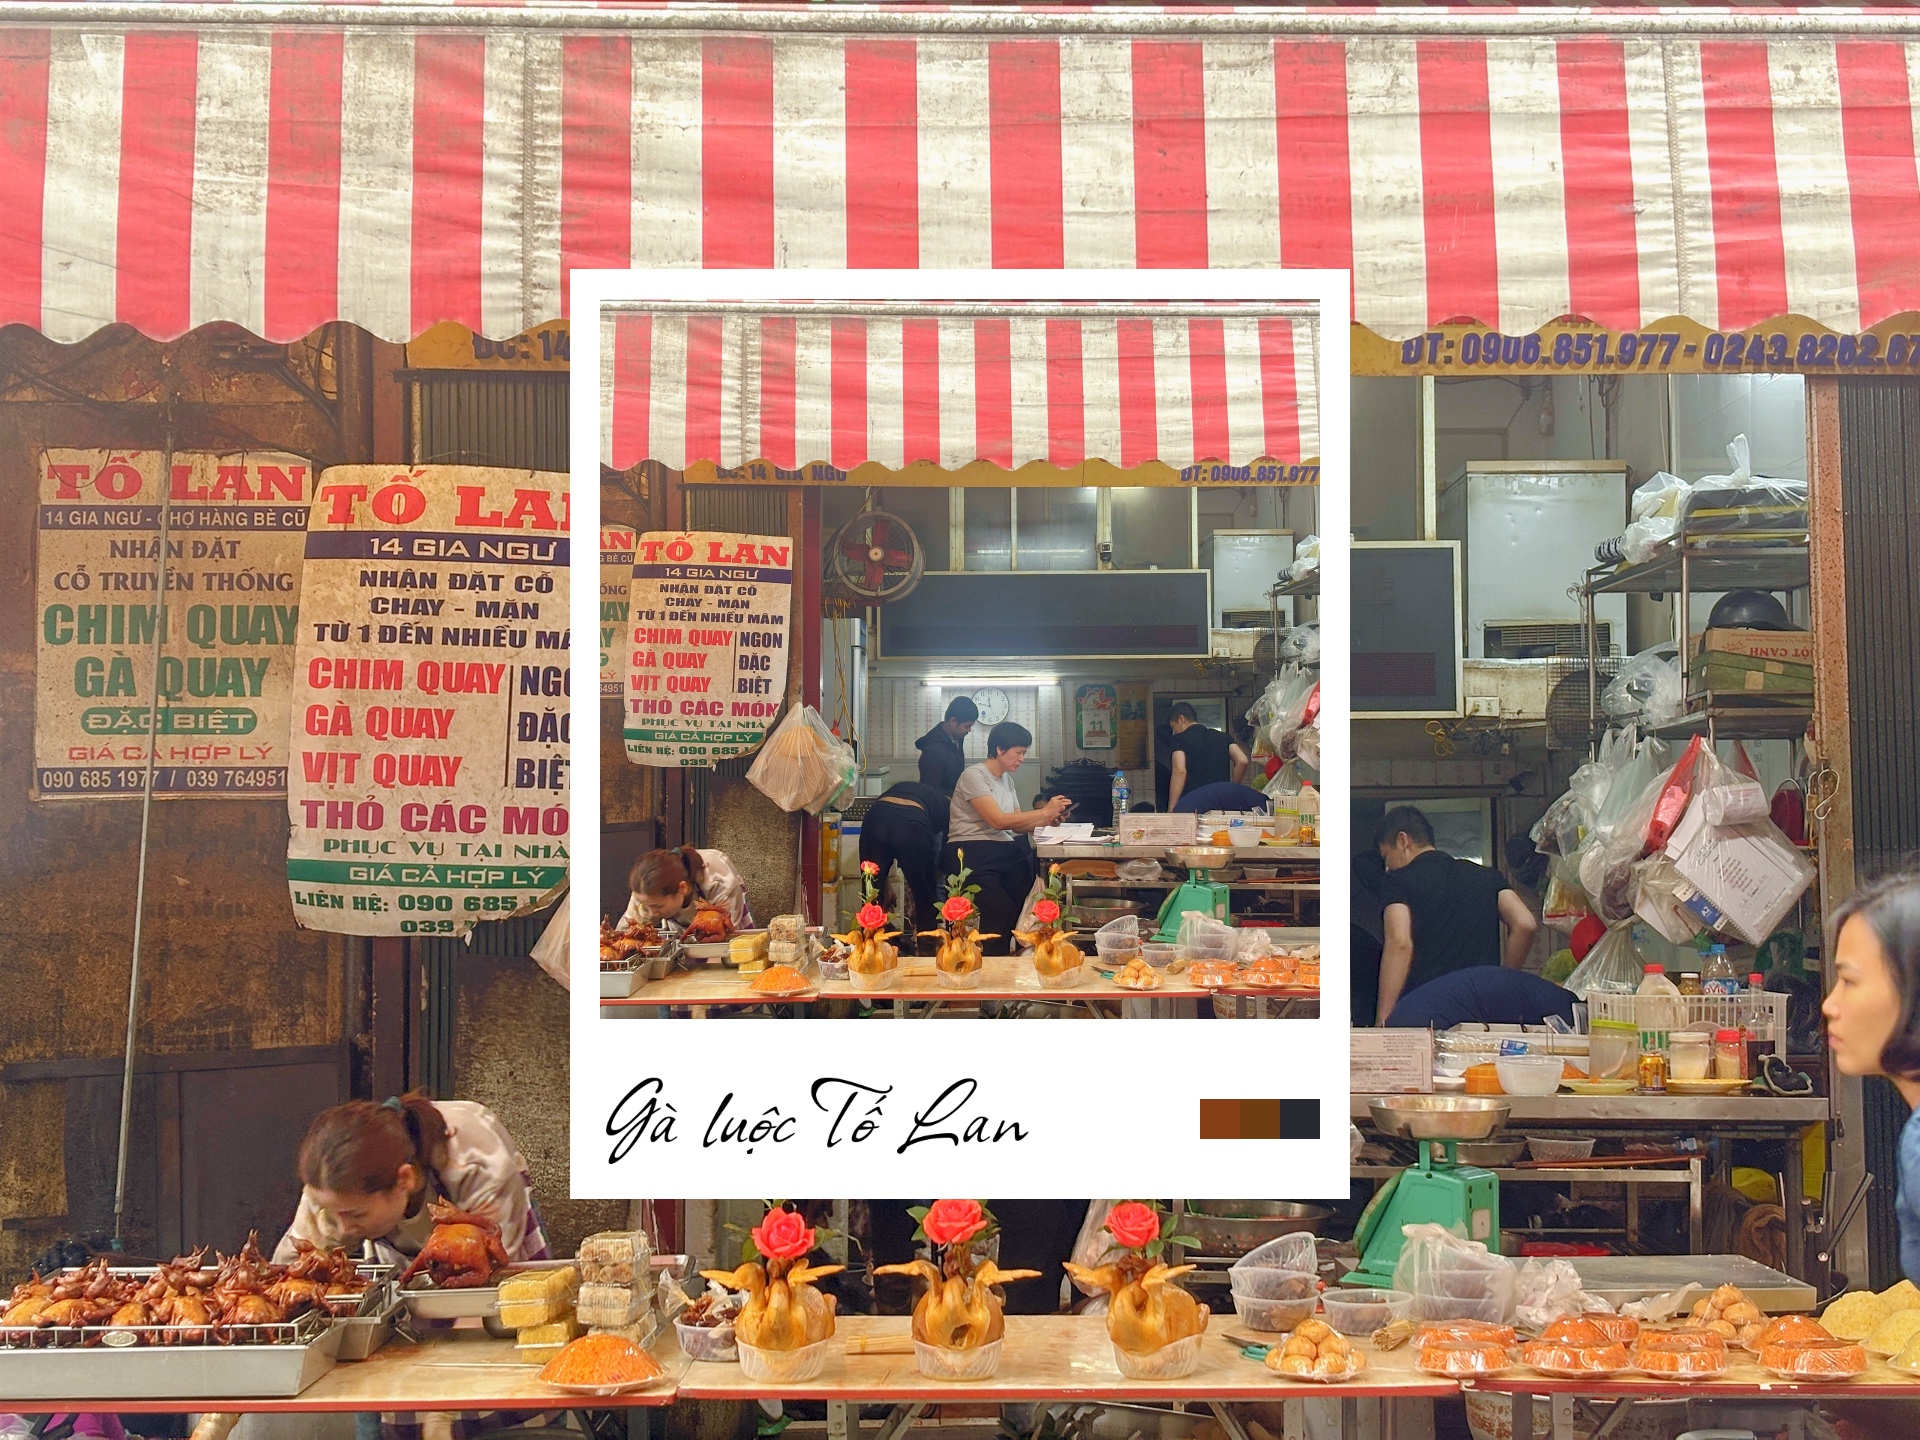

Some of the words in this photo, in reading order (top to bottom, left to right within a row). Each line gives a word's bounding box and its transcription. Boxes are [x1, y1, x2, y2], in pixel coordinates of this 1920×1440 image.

[537, 329, 570, 362] 14
[1461, 332, 1681, 366] 0906.851.977
[47, 451, 143, 500] TỐ
[169, 465, 306, 501] LAN
[749, 463, 767, 480] 14
[1210, 464, 1320, 483] 0906.851.977
[320, 469, 428, 525] TỐ
[454, 485, 570, 532] LA
[45, 510, 64, 525] 14
[68, 510, 99, 526] GIA
[103, 508, 142, 526] NGƯ
[199, 508, 248, 527] HÀNG
[253, 507, 277, 526] BÈ
[281, 508, 306, 527] CŨ
[109, 535, 184, 563] NHẬN
[191, 536, 242, 563] ĐẶT
[370, 537, 404, 556] 14
[412, 537, 471, 558] GIA
[478, 540, 558, 562] NGƯ
[606, 552, 619, 562] BÈ
[640, 533, 694, 562] TỐ
[707, 541, 790, 567] LAN
[53, 564, 91, 591] CỖ
[98, 565, 194, 591] TRUYỀN
[201, 566, 294, 591] THỐNG
[359, 568, 438, 592] NHẬN
[447, 571, 505, 594] ĐẶT
[513, 570, 554, 594] CỖ
[664, 567, 682, 577] 14
[686, 568, 716, 579] GIA
[719, 568, 760, 580] NGƯ
[659, 582, 699, 596] NHẬN
[703, 583, 733, 597] ĐẶT
[370, 597, 446, 617] CHAY
[474, 599, 540, 624] MẶN
[665, 597, 703, 607] CHAY
[717, 598, 750, 611] MẶN
[43, 603, 168, 645] CHIM
[186, 603, 299, 649] QUAY
[636, 608, 656, 621] TỪ
[658, 610, 666, 621] 1
[668, 609, 698, 622] ĐẾN
[700, 610, 744, 624] NHIỀU
[747, 613, 784, 625] MÂM
[313, 620, 350, 643] TỪ
[357, 624, 371, 643] 1
[377, 620, 434, 646] ĐẾN
[440, 621, 528, 649] NHIỀU
[633, 627, 683, 645] CHIM
[688, 629, 734, 647] QUAY
[739, 631, 783, 649] NGON
[632, 649, 657, 668] GÀ
[662, 651, 708, 670] QUAY
[738, 652, 771, 674] ĐẶC
[1749, 647, 1788, 657] CANH
[1792, 646, 1814, 659] ỘT
[74, 650, 137, 698] GÀ
[157, 656, 271, 702] QUAY
[308, 656, 404, 691] CHIM
[416, 660, 506, 696] QUAY
[519, 665, 570, 697] NG
[631, 674, 661, 694] VỊT
[666, 675, 712, 694] QUAY
[737, 675, 773, 697] BIỆT
[630, 696, 673, 715] THỎ
[679, 698, 724, 717] CÁC
[731, 700, 780, 718] MÓN
[86, 710, 162, 733] ĐẶC
[173, 709, 253, 734] BIỆT
[305, 700, 353, 737] GÀ
[365, 705, 456, 741] QUAY
[641, 717, 679, 729] PHỤC
[684, 718, 703, 730] VỤ
[707, 719, 732, 731] TẠI
[736, 718, 766, 729] NHÀ
[654, 730, 676, 740] GIÁ
[680, 731, 702, 741] CẢ
[703, 732, 733, 743] HỢP
[735, 731, 753, 742] LÝ
[68, 742, 116, 761] GIÁ
[170, 744, 231, 764] HỢP
[239, 742, 273, 760] LÝ
[626, 743, 653, 754] LIÊN
[656, 745, 676, 757] HỆ:
[678, 746, 707, 755] 090
[711, 746, 740, 756] 685
[301, 751, 362, 790] VỊT
[372, 752, 463, 790] QUAY
[679, 758, 708, 766] 039
[42, 770, 74, 788] 090
[79, 770, 111, 788] 685
[117, 769, 160, 788] 1977
[186, 770, 219, 788] 039
[223, 769, 287, 788] 764951
[515, 753, 570, 796] BIỆ
[299, 794, 385, 831] THỎ
[400, 799, 487, 834] CÁC
[323, 838, 397, 859] PHỤC
[409, 840, 445, 861] VỤ
[455, 842, 503, 862] TẠI
[513, 840, 570, 859] NHÀ
[349, 863, 396, 882] GIÁ
[401, 864, 442, 883] CẢ
[446, 868, 505, 888] HỢP
[511, 867, 546, 886] LÝ
[294, 889, 344, 909] LIÊN
[352, 892, 389, 916] HỆ:
[397, 894, 454, 912] 090
[463, 895, 519, 912] 685
[400, 920, 455, 933] 039
